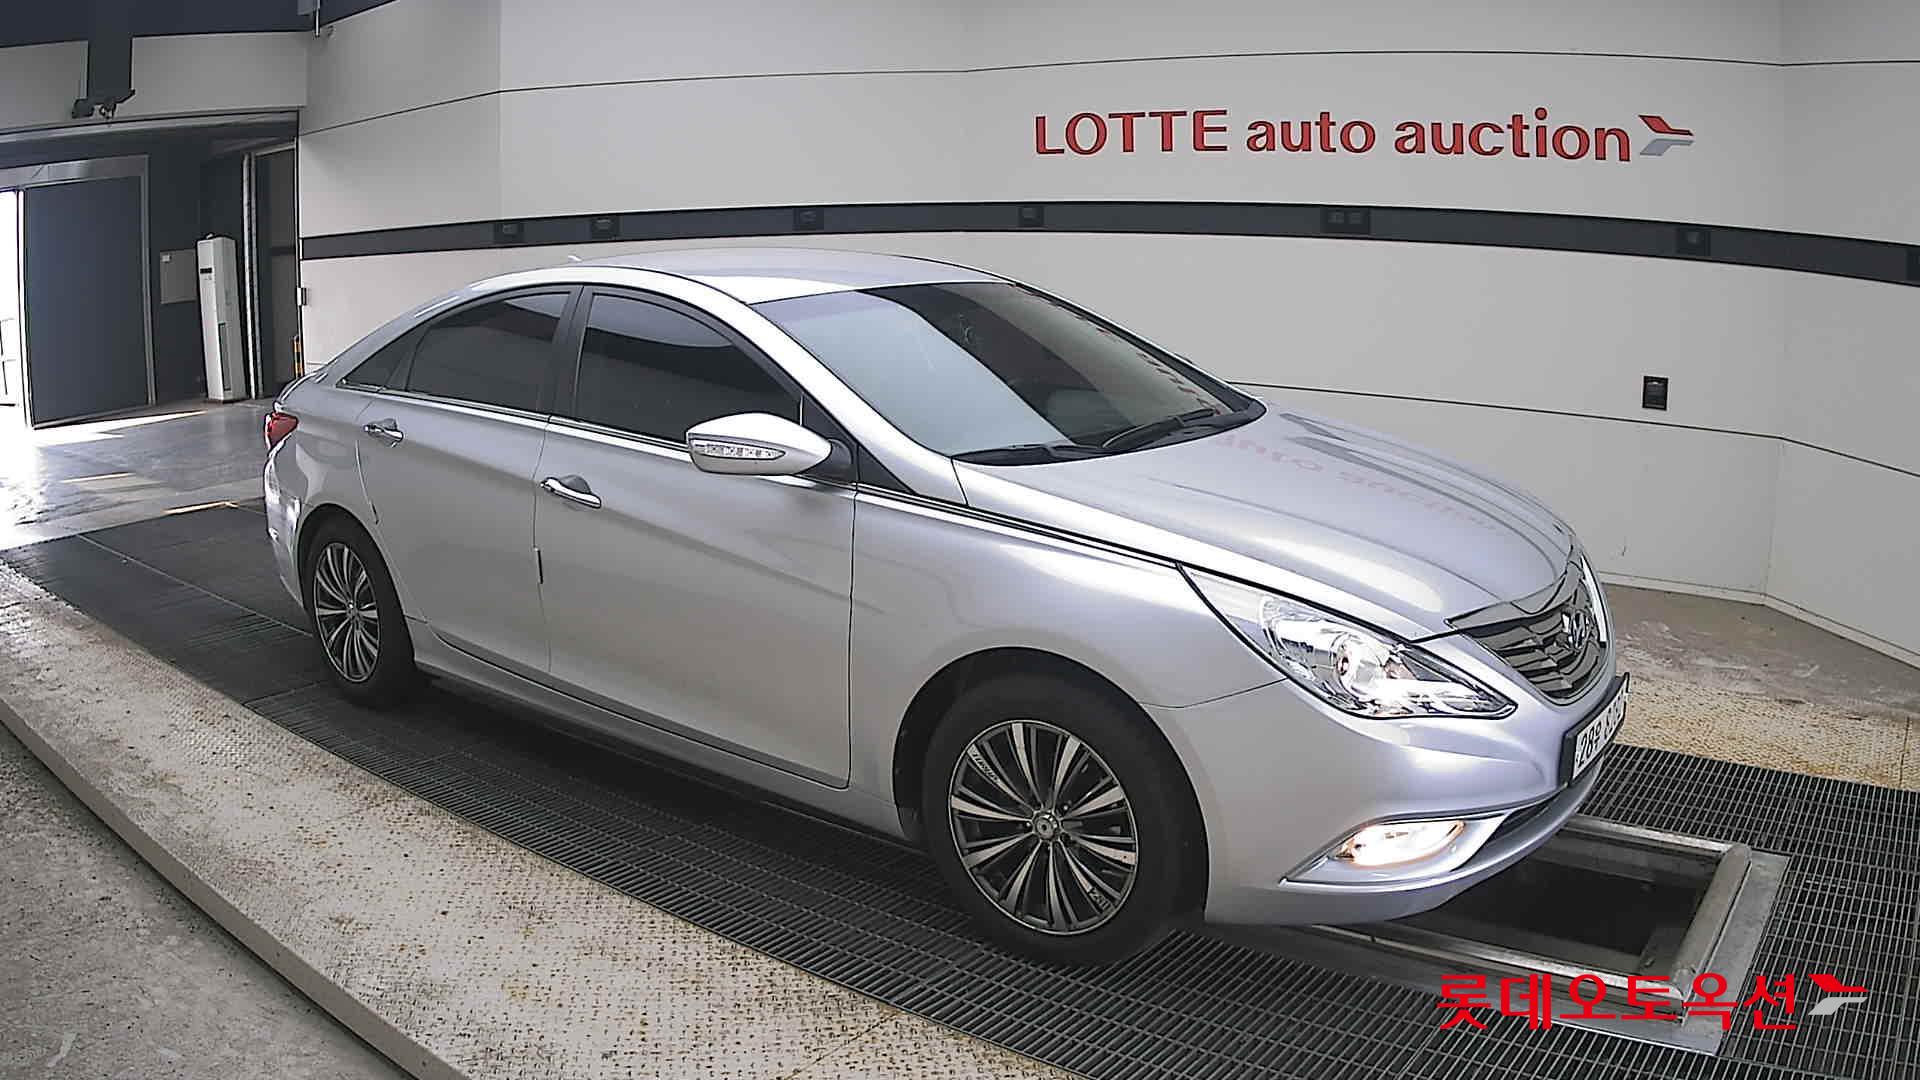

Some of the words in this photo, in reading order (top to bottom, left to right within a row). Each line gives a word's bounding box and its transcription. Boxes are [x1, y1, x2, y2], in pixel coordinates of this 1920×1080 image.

[1034, 108, 1229, 156] LOTTE
[1245, 110, 1377, 154] auto
[1393, 106, 1632, 162] auction
